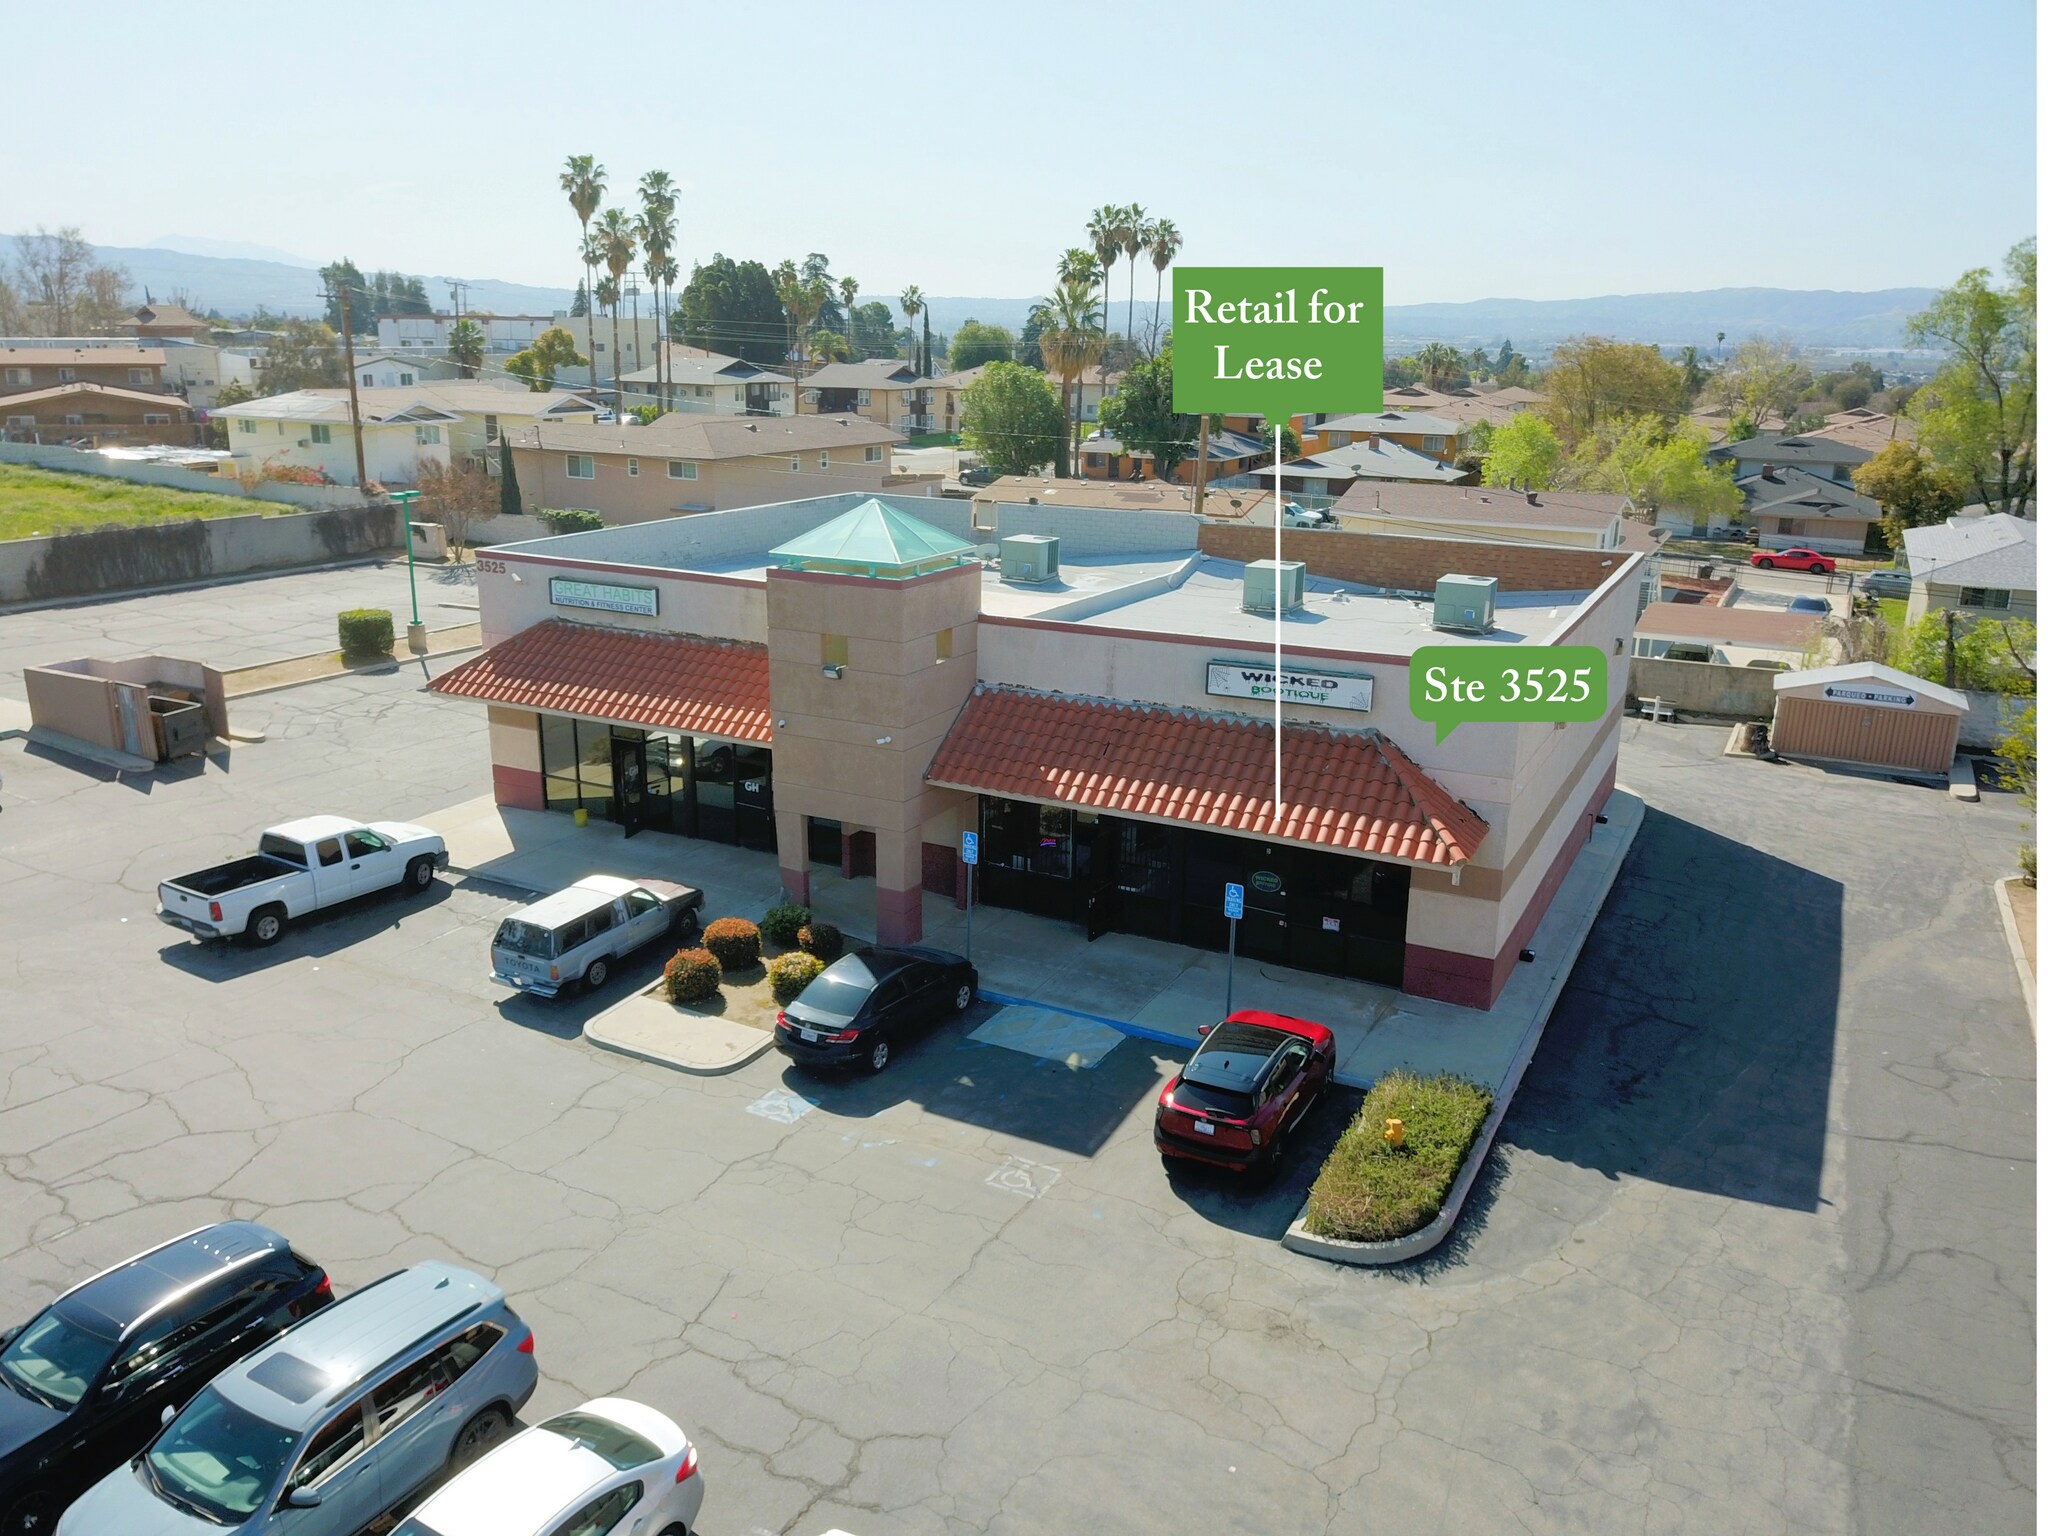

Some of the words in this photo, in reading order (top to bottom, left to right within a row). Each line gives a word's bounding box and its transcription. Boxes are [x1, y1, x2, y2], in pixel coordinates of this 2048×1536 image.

[477, 560, 506, 574] 3525
[554, 581, 599, 598] GREAT
[603, 587, 653, 604] HABITS
[555, 597, 590, 607] NUTRITION
[596, 601, 624, 610] FITNESS
[625, 603, 653, 613] CENTER
[1241, 672, 1338, 690] WICKED
[1832, 689, 1867, 699] PARQUEO
[1873, 694, 1907, 704] PARKING
[744, 781, 760, 793] GH
[504, 957, 540, 973] TOYOTA
